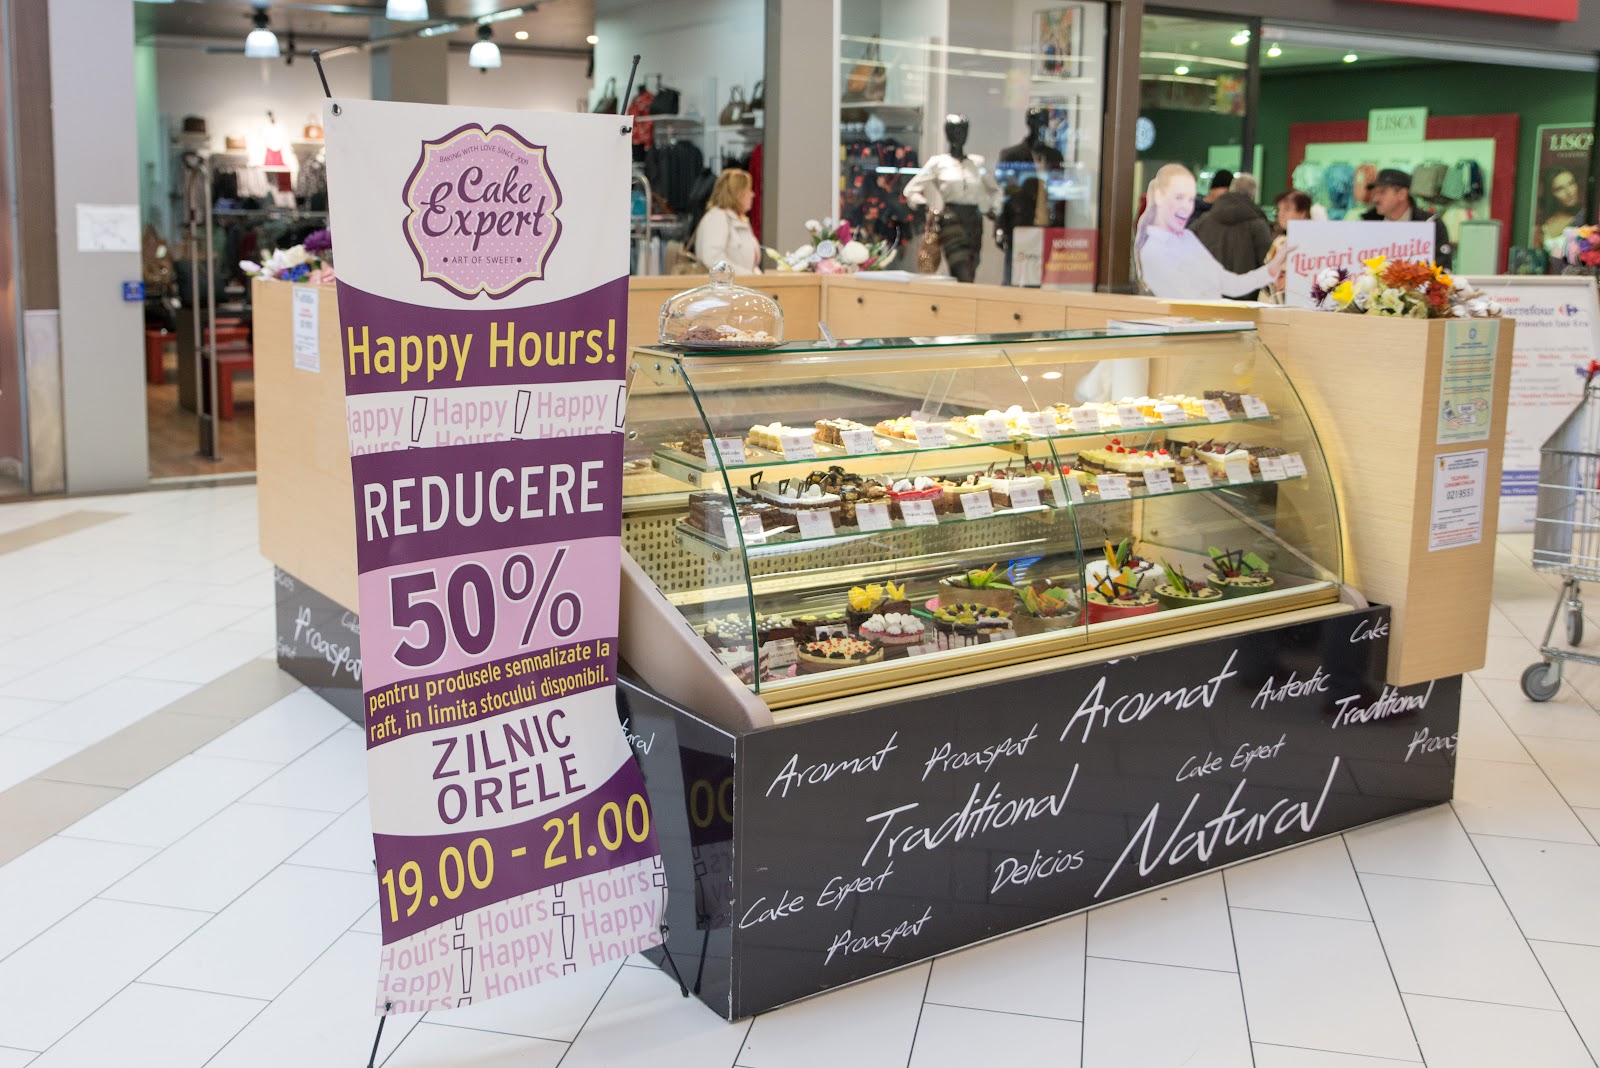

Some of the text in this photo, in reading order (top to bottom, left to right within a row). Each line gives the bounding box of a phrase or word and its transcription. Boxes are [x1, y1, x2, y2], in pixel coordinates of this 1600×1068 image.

[439, 152, 462, 163] BAKING
[462, 146, 479, 155] WITH
[497, 147, 515, 159] SINCE
[1375, 115, 1416, 130] LISCA
[421, 182, 546, 251] Expert
[457, 165, 533, 204] Cake
[471, 256, 482, 264] OF
[486, 256, 514, 264] SWEET
[1505, 305, 1555, 316] arrefour
[347, 325, 473, 384] Happy
[489, 319, 616, 368] Hours!
[348, 404, 404, 440] appy
[433, 397, 508, 430] Happy
[537, 392, 609, 423] Happy
[363, 460, 604, 541] REDUCERE
[390, 545, 583, 669] 50%
[1350, 617, 1389, 643] Cake
[368, 640, 610, 716] pentru produsele semnalizate la
[370, 664, 610, 742] raft, in limita stocului disponibil.
[1060, 648, 1238, 743] Aromat
[1250, 666, 1331, 710] Autentic
[432, 709, 571, 780] ZILNIC
[765, 731, 898, 798] Aromat
[922, 723, 1038, 781] Proaspat
[1175, 733, 1288, 782] Cake Expert
[437, 753, 586, 825] ORELE
[862, 763, 1080, 867] Traditional
[381, 837, 495, 923] 19.00
[542, 793, 650, 870] 21.00
[1094, 756, 1341, 898] Natural
[738, 860, 894, 929] Cake Expert
[991, 848, 1084, 894] Delicios
[380, 871, 650, 971] Hours Hours Hours
[479, 928, 553, 972] Happy
[581, 900, 655, 939] Happy
[824, 906, 932, 966] Proaspat
